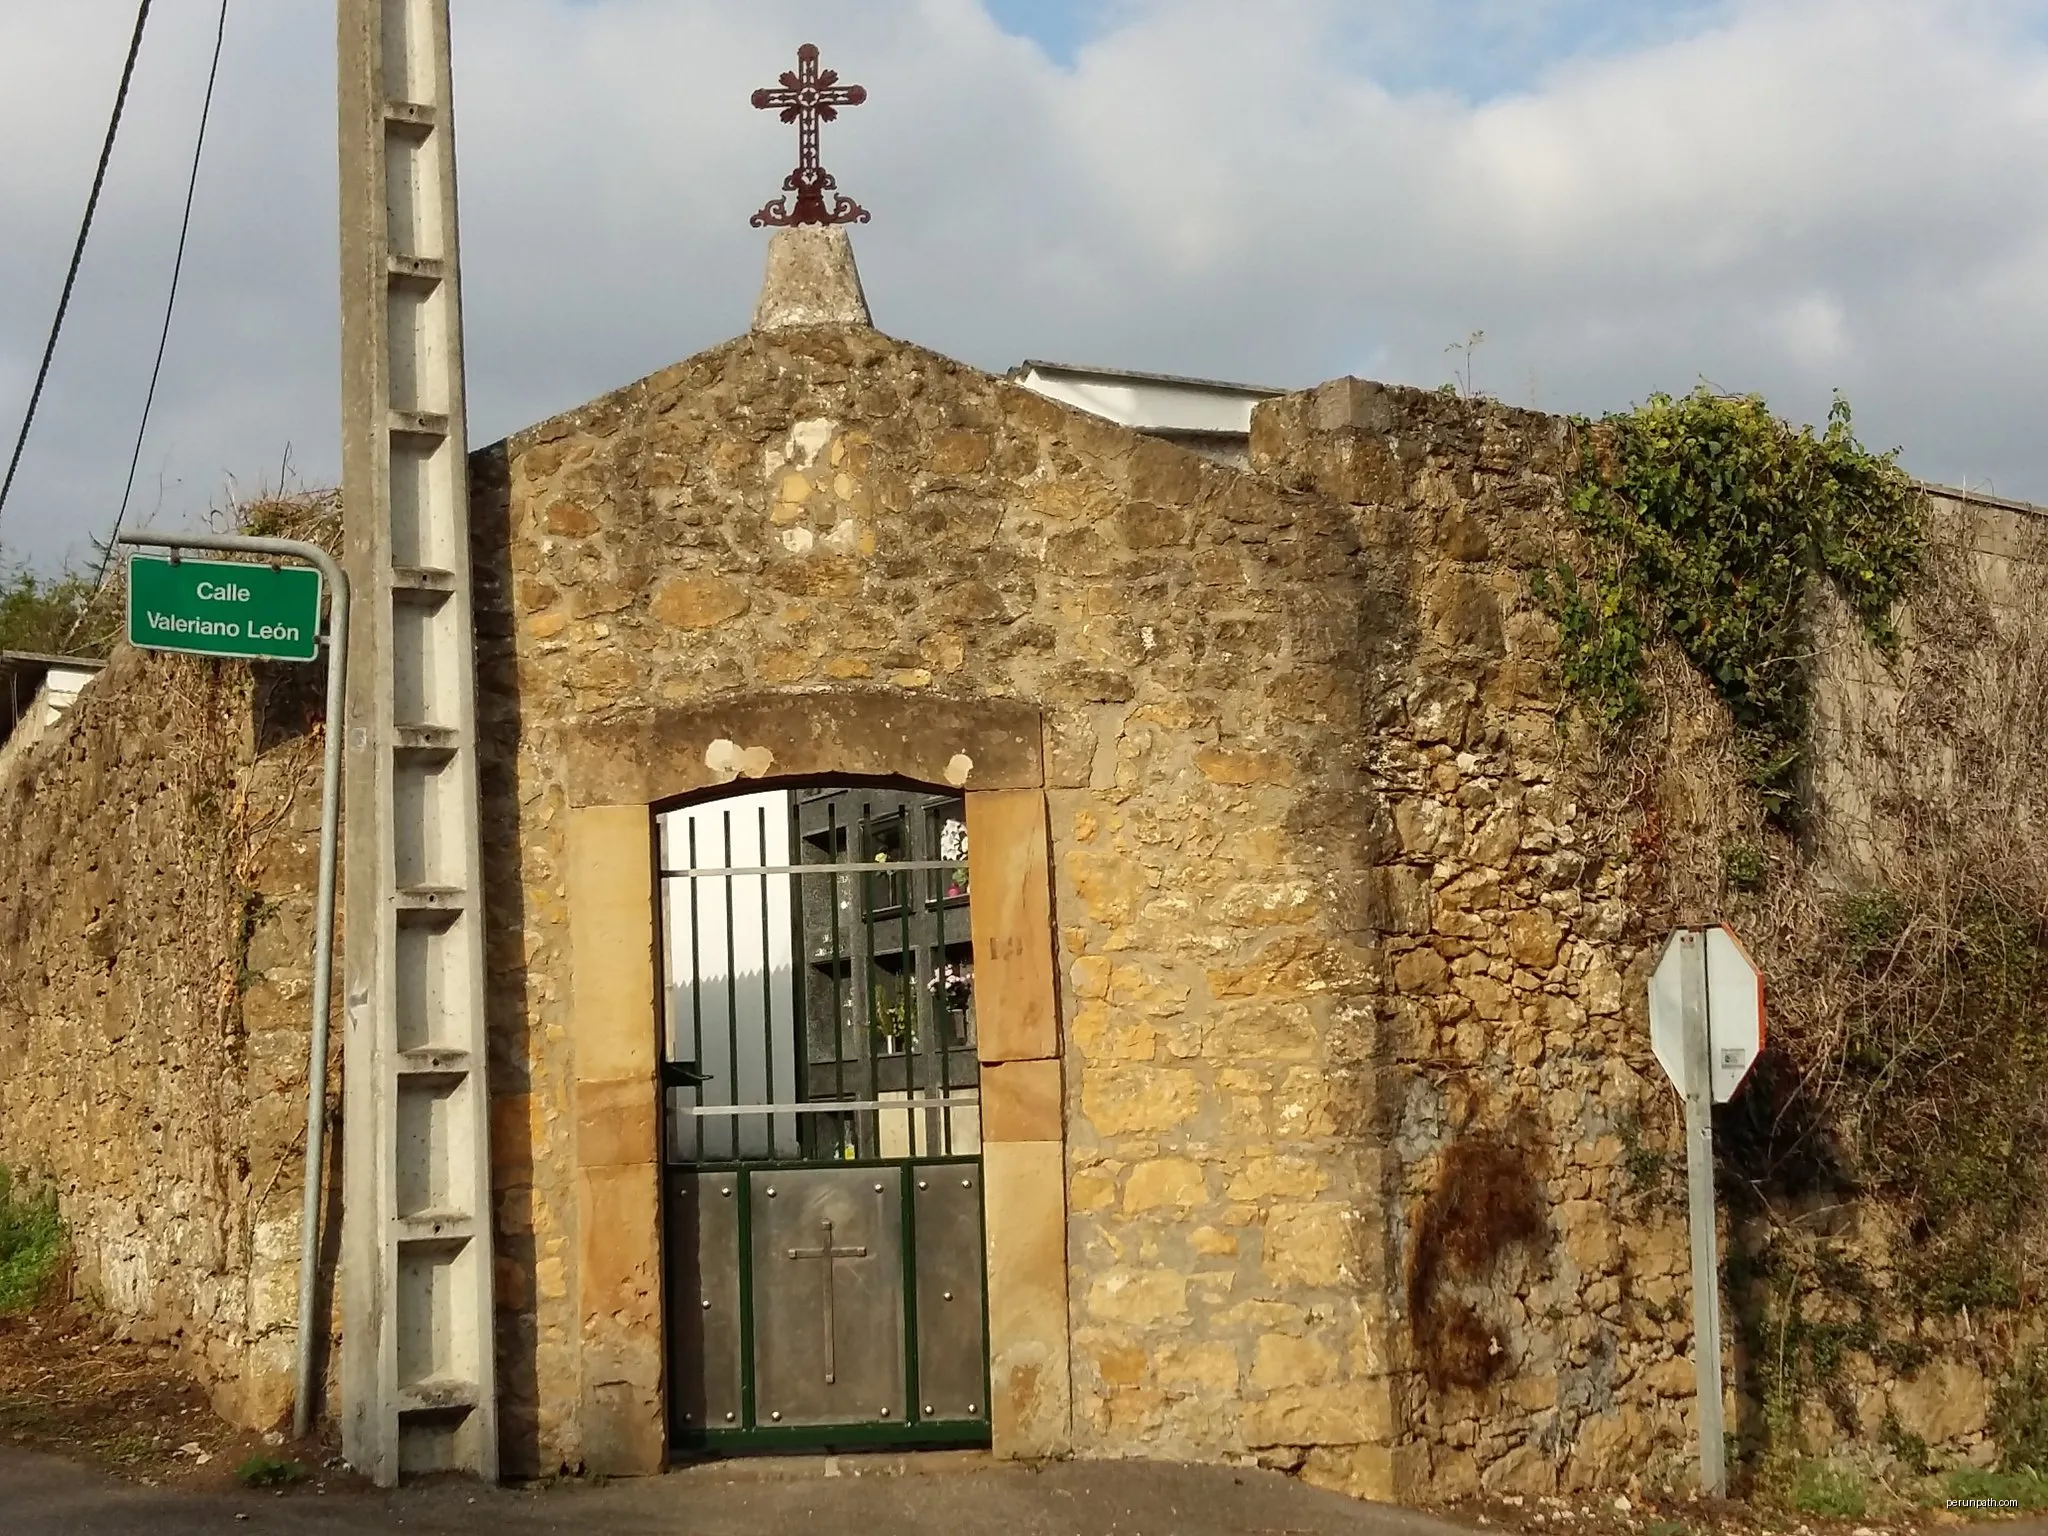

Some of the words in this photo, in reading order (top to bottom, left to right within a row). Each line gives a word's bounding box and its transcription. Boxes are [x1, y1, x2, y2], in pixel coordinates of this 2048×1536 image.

[197, 582, 251, 602] Calle
[147, 611, 240, 637] Valeriano
[247, 620, 299, 641] León
